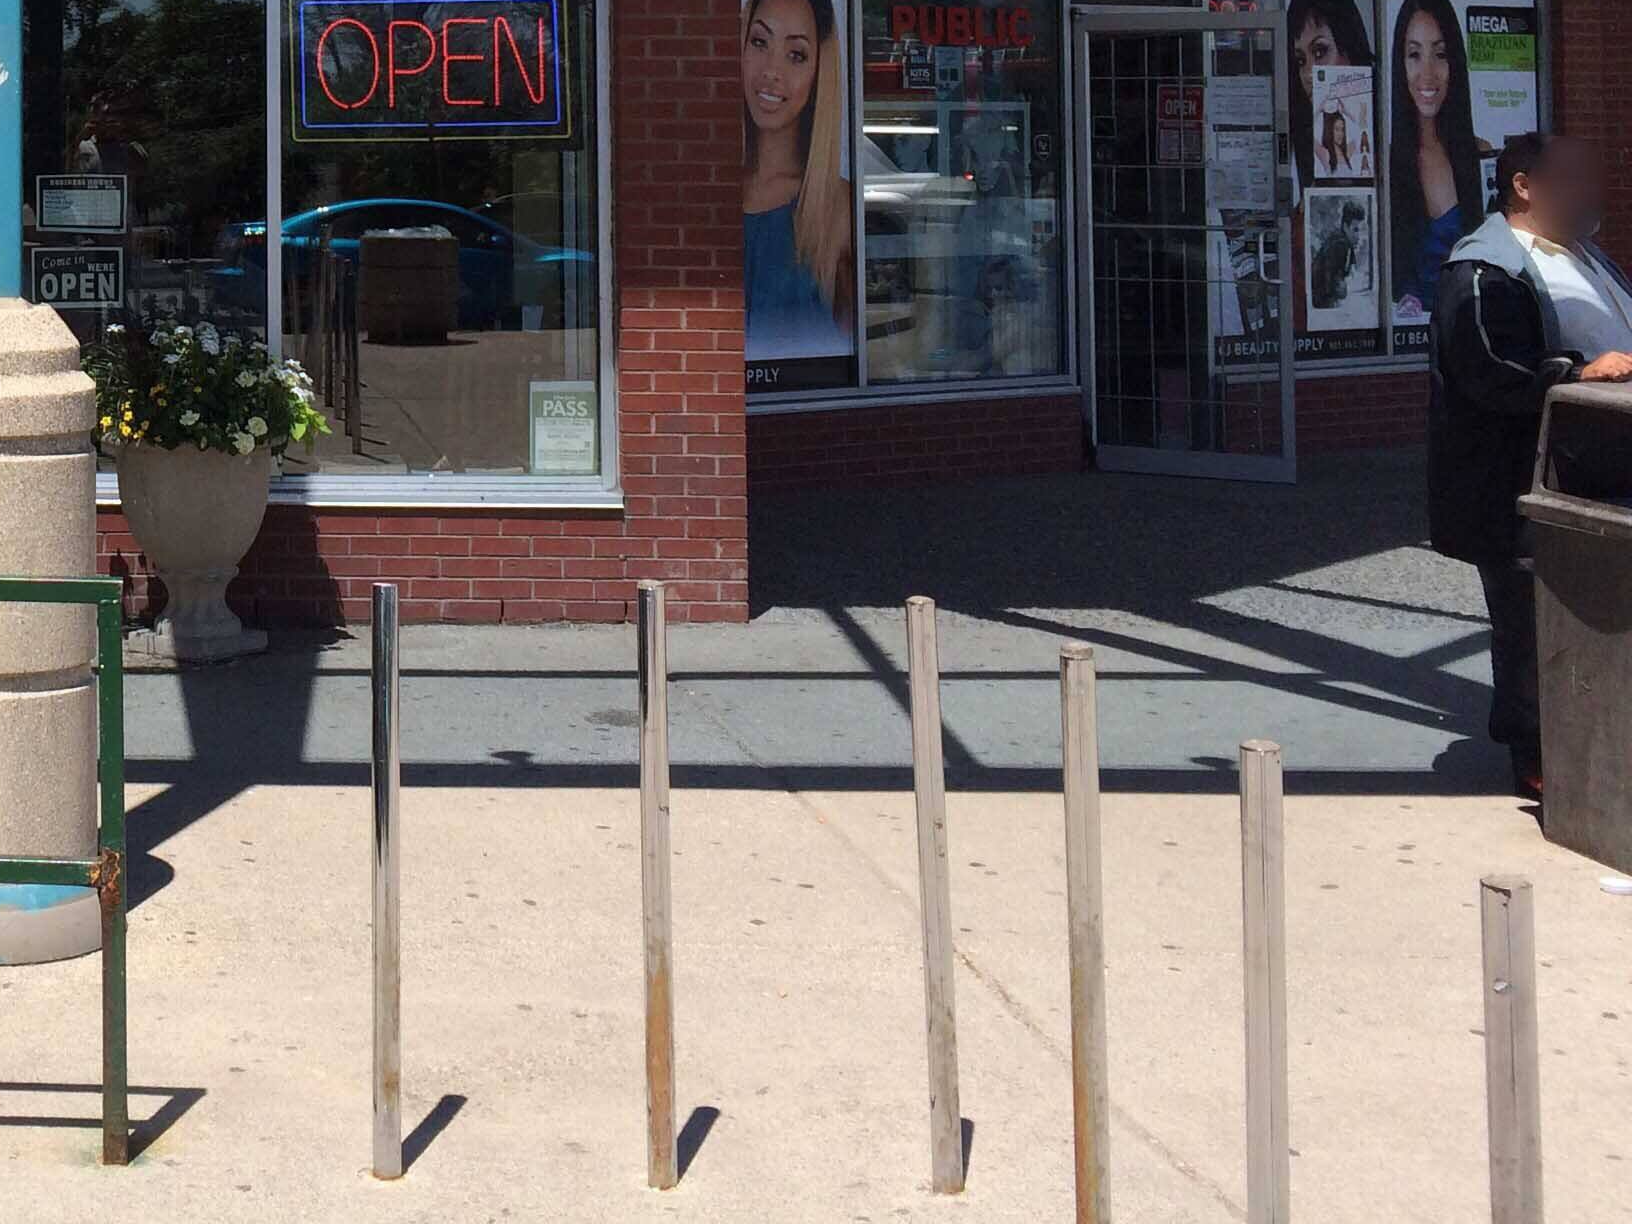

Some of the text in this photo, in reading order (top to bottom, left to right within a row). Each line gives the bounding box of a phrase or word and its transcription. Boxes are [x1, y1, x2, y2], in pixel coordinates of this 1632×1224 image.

[892, 4, 1035, 47] PUBLIC
[1469, 16, 1509, 33] MEGA
[316, 16, 545, 109] OPEN
[41, 256, 72, 270] Come
[40, 272, 116, 300] OPEN
[1294, 337, 1325, 352] PPLY
[1408, 331, 1430, 345] BEA
[746, 368, 780, 383] PPLY
[542, 400, 589, 417] PASS
